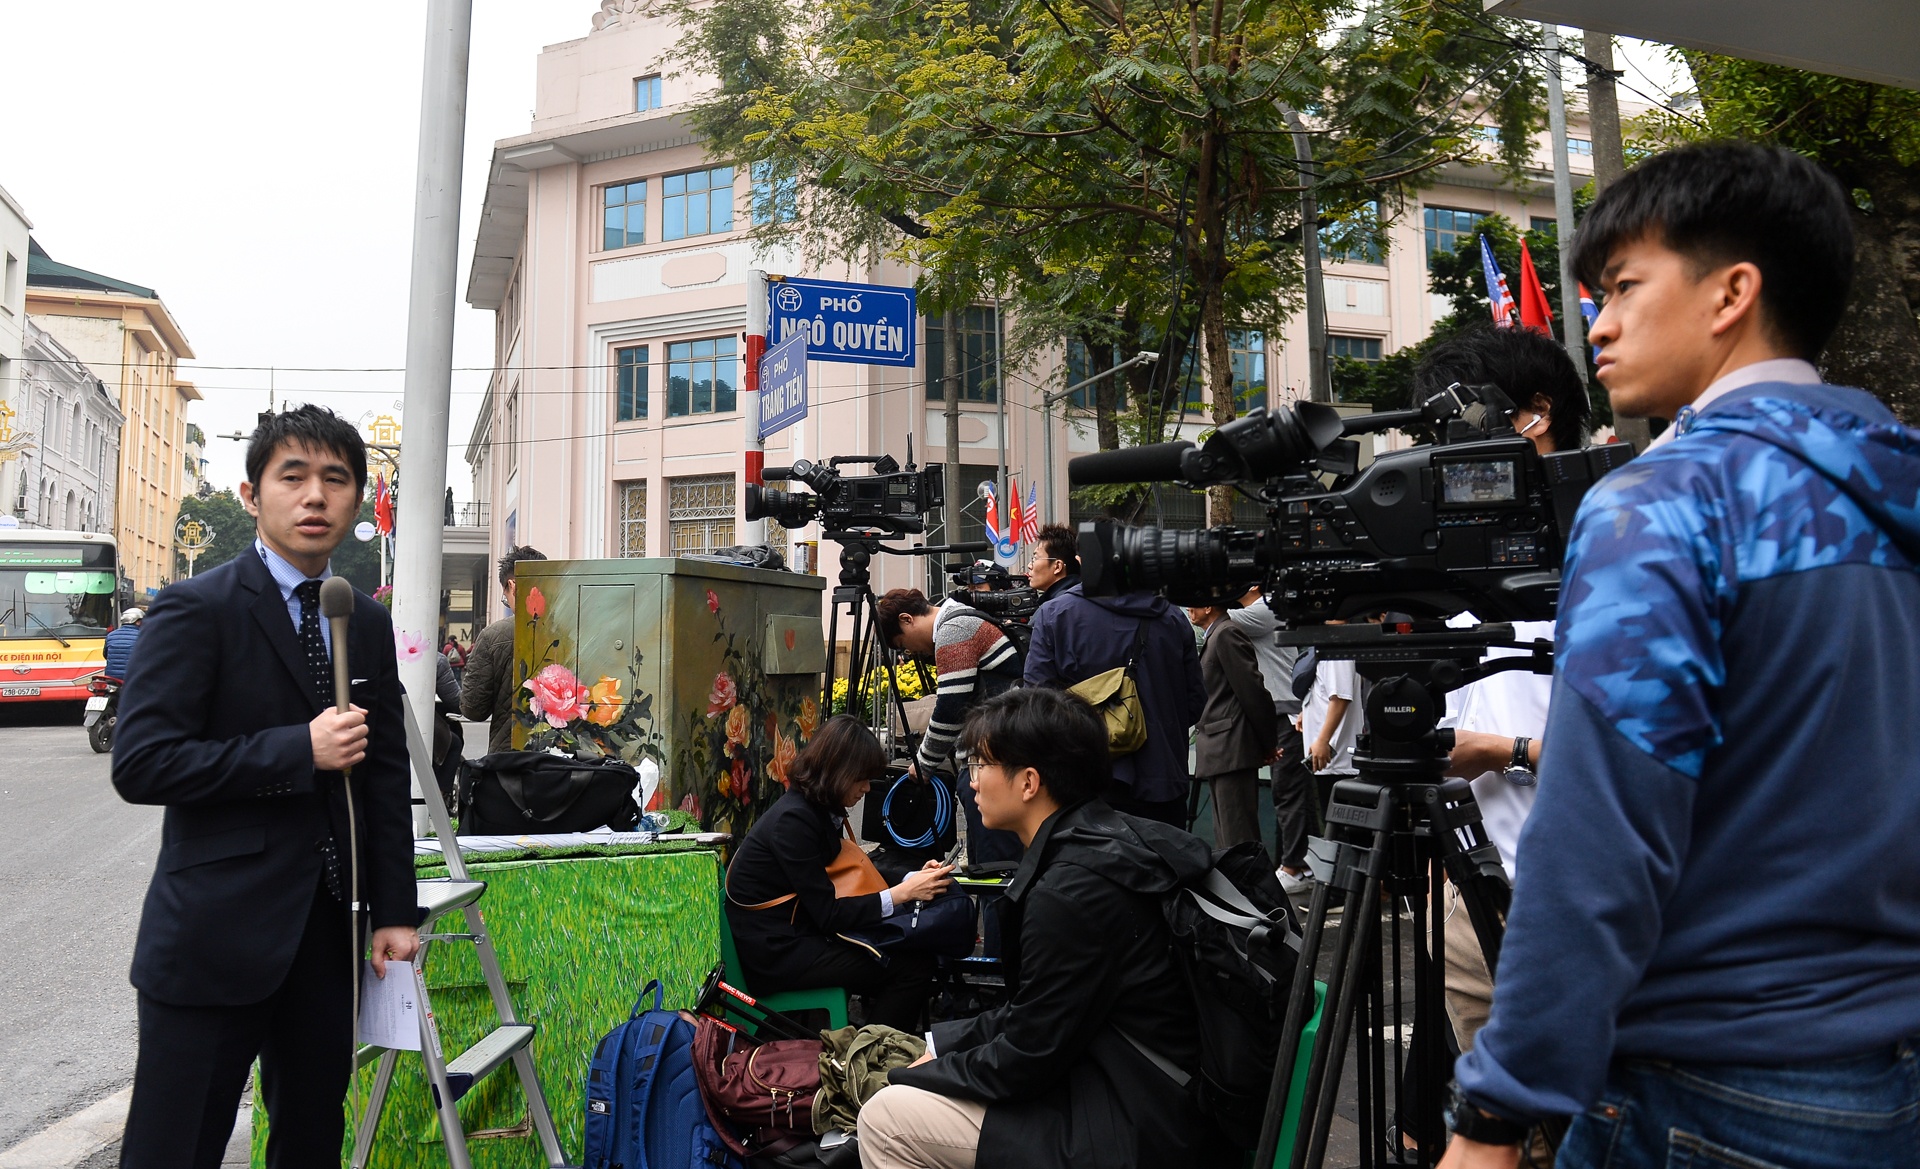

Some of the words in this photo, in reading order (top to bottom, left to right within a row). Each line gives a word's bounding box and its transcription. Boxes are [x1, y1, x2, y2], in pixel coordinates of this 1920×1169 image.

[820, 293, 863, 313] PHỐ
[833, 316, 903, 353] QUYỀN
[773, 349, 789, 379] PHỐ
[762, 385, 785, 423] TRÀNG
[786, 367, 803, 410] TIỀN
[46, 652, 62, 663] NỘI
[1332, 806, 1365, 823] MILLER
[722, 982, 737, 994] MBC
[736, 990, 753, 1003] NEWS
